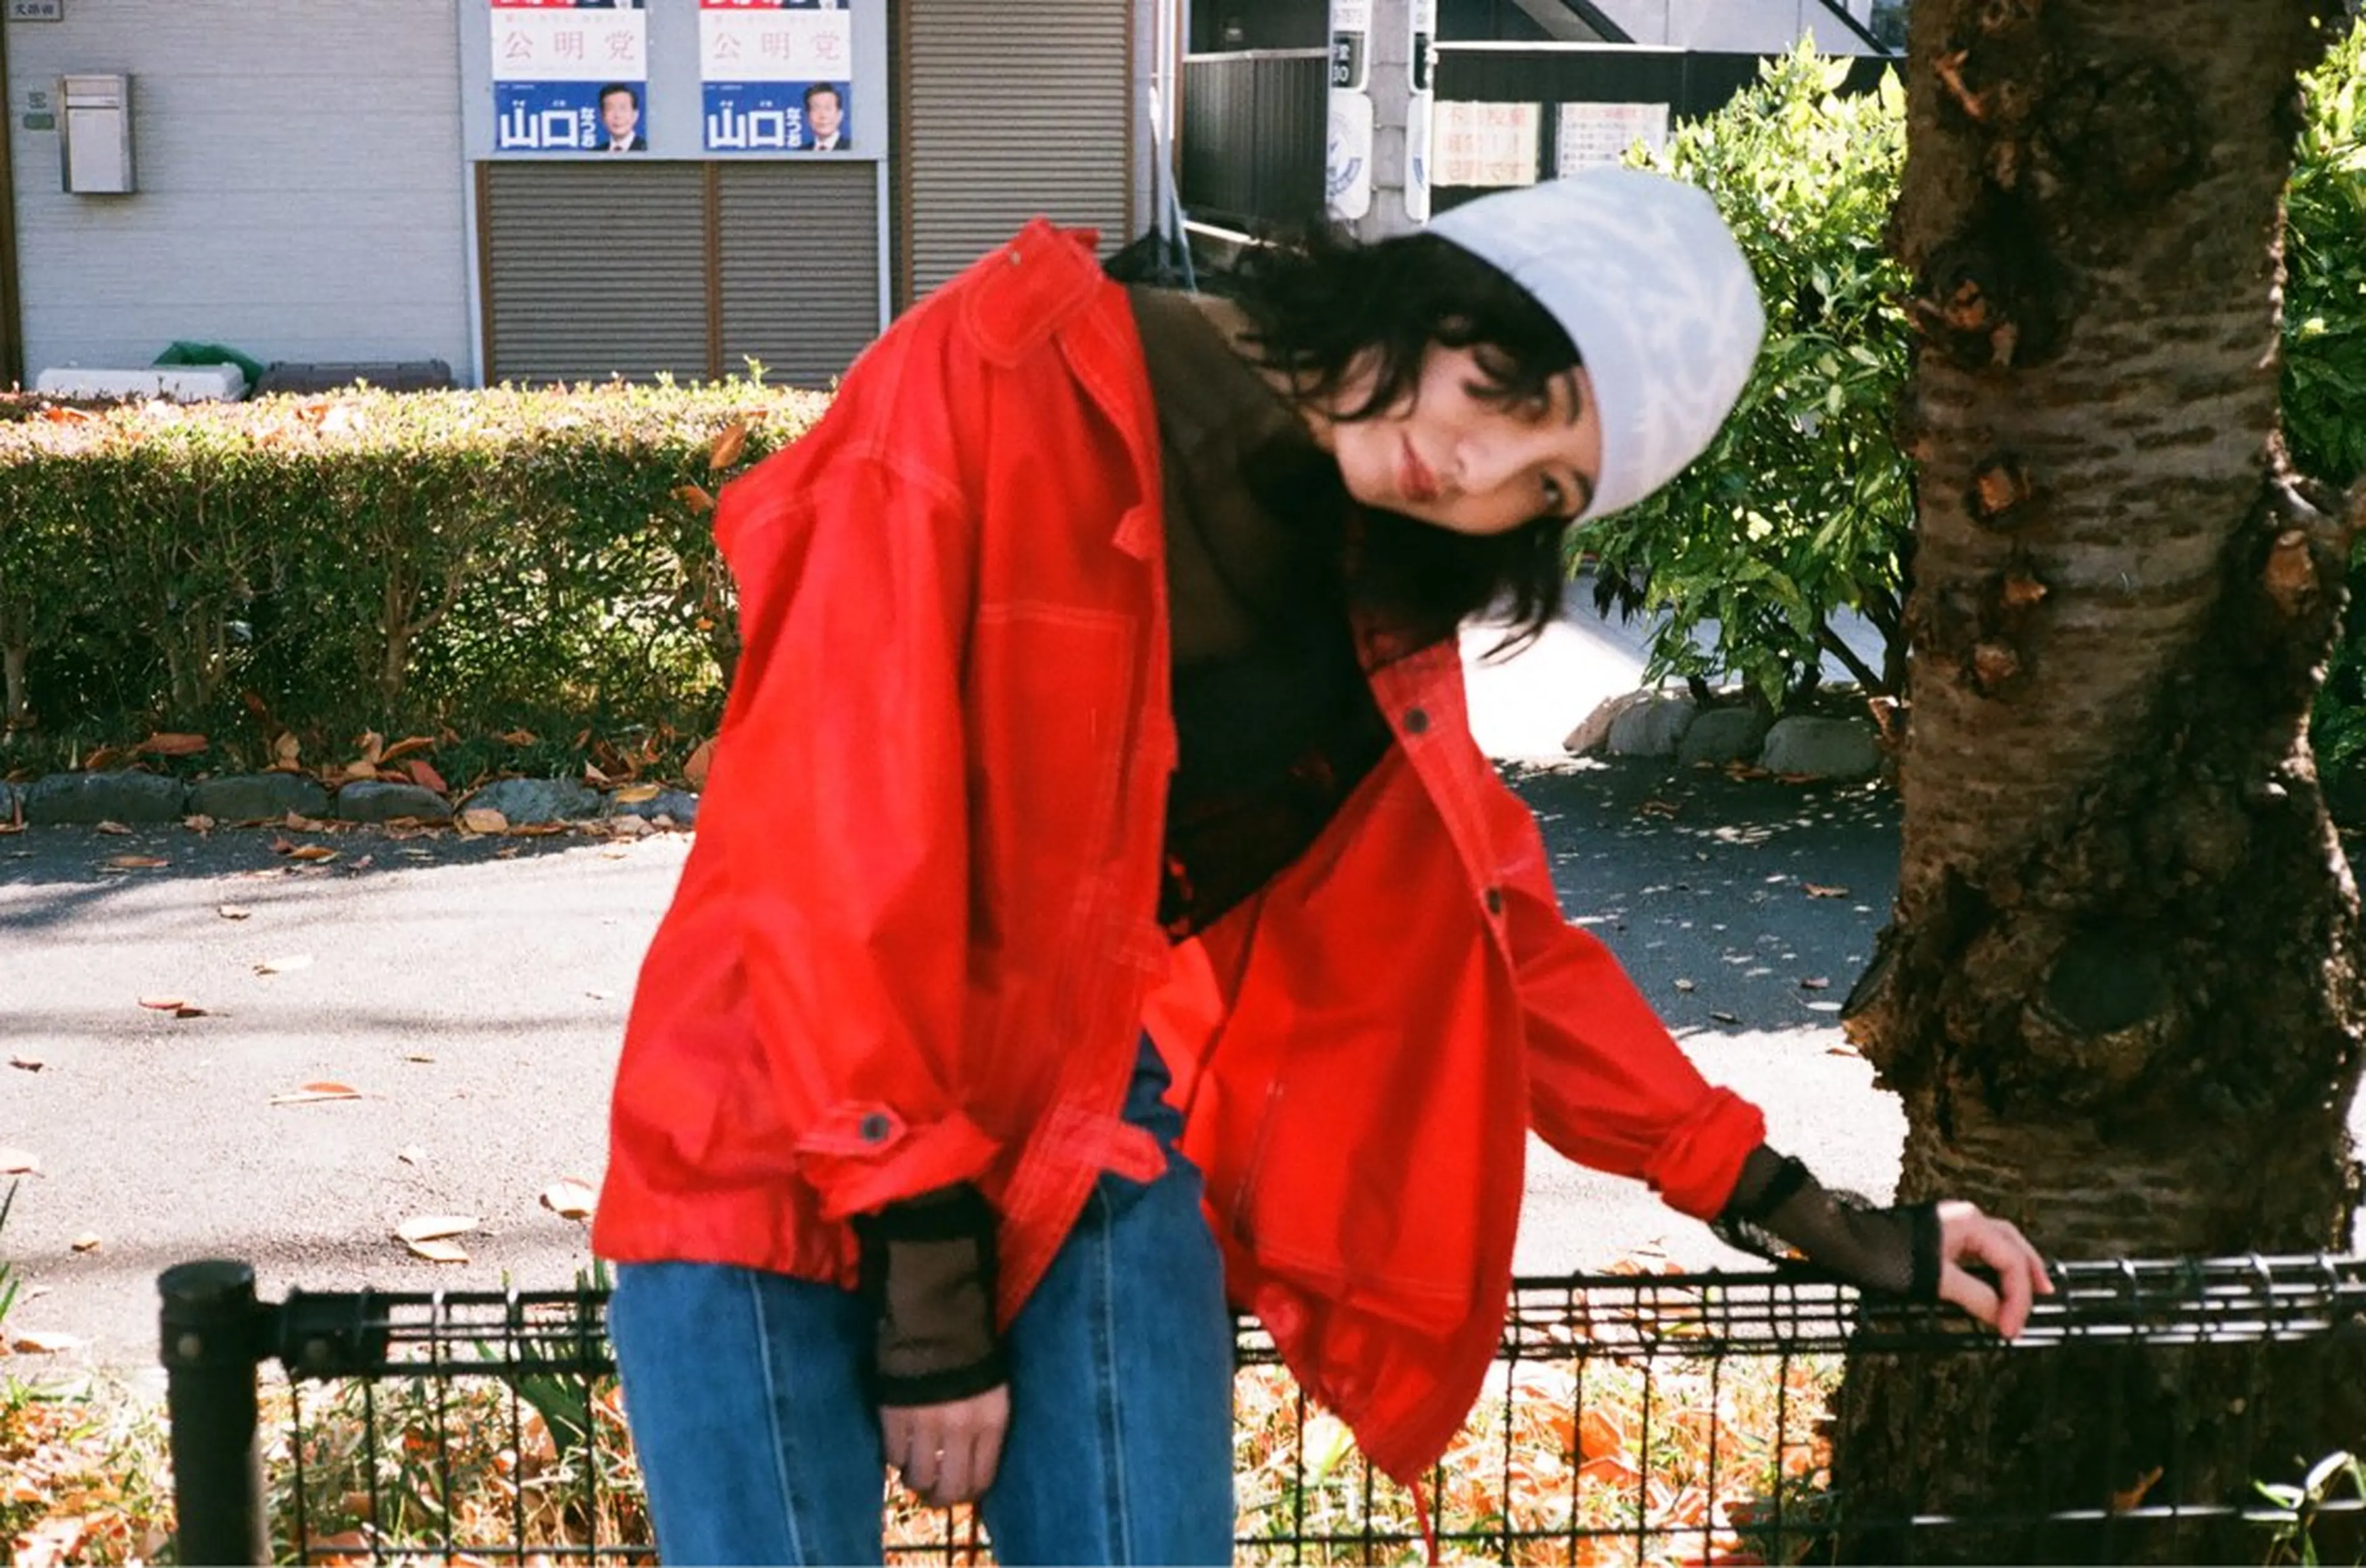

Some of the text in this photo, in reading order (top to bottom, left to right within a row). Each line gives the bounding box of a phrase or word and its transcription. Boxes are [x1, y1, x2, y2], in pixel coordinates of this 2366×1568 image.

[505, 29, 635, 60] 公明党
[713, 30, 840, 60] 公明党
[500, 107, 578, 148] 山口
[707, 107, 785, 148] 山口
